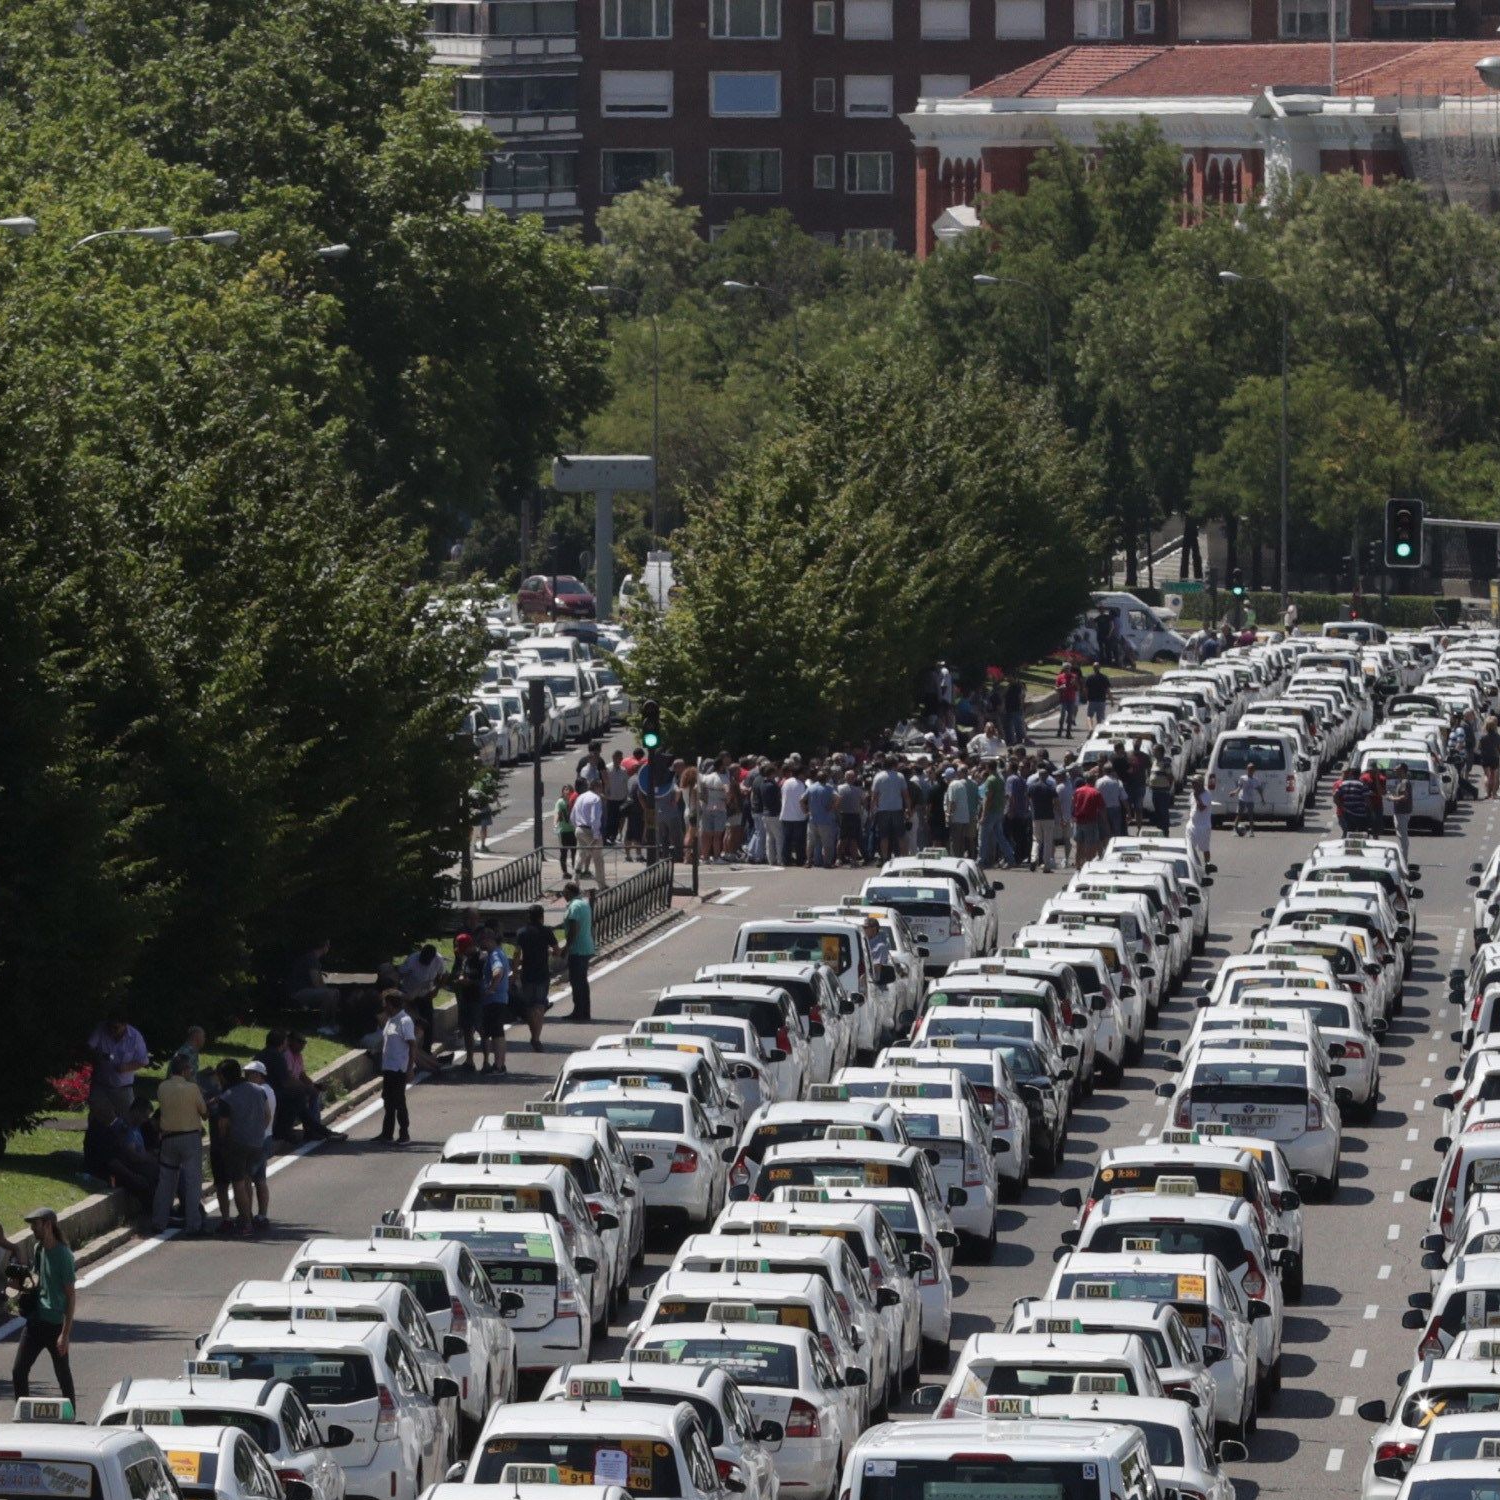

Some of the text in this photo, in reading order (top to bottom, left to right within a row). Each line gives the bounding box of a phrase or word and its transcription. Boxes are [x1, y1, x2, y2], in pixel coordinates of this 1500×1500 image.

[465, 1197, 491, 1208] TAXI
[321, 1268, 341, 1279] TAXI
[1089, 1285, 1108, 1296] TAXI
[34, 1404, 59, 1418] TAXI
